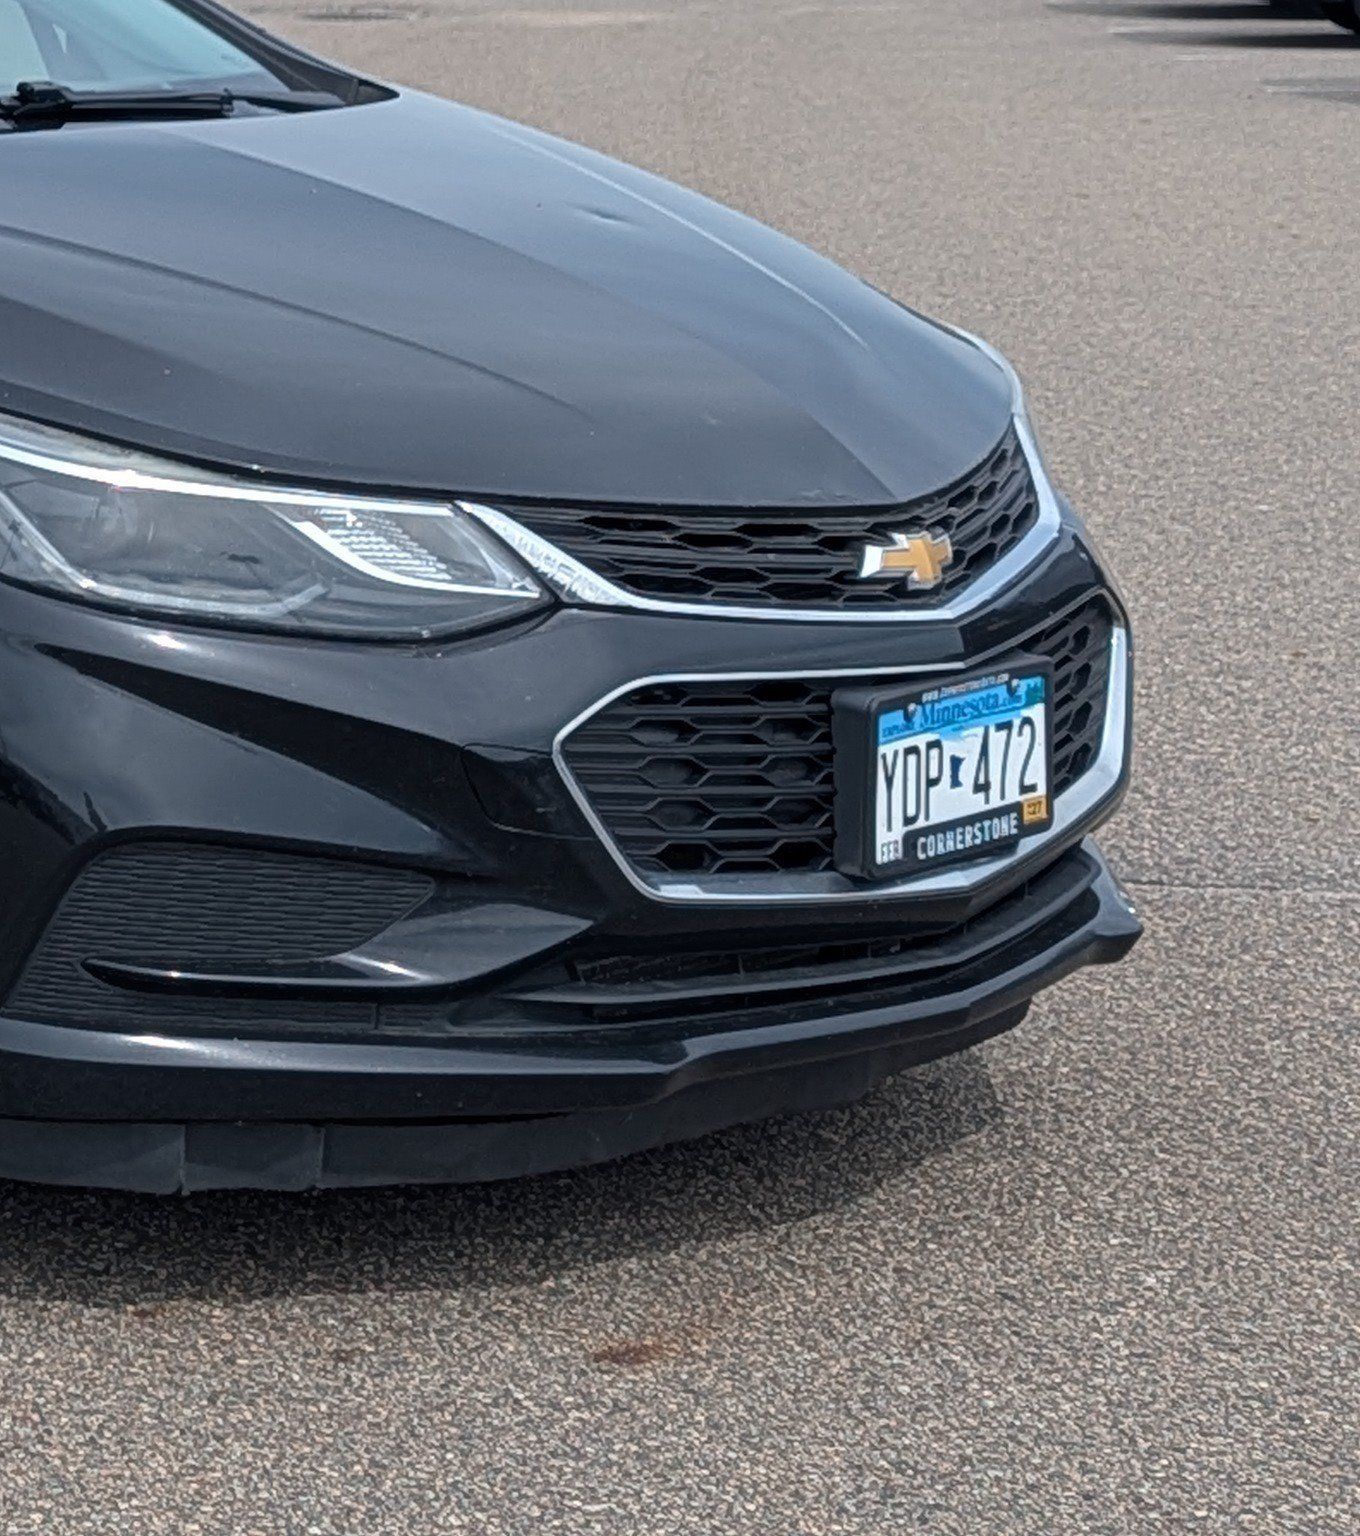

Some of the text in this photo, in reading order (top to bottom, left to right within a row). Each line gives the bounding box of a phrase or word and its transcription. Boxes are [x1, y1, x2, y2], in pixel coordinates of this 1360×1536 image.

[880, 715, 1038, 833] YDP 472
[916, 811, 1018, 861] CORNERSTONE
